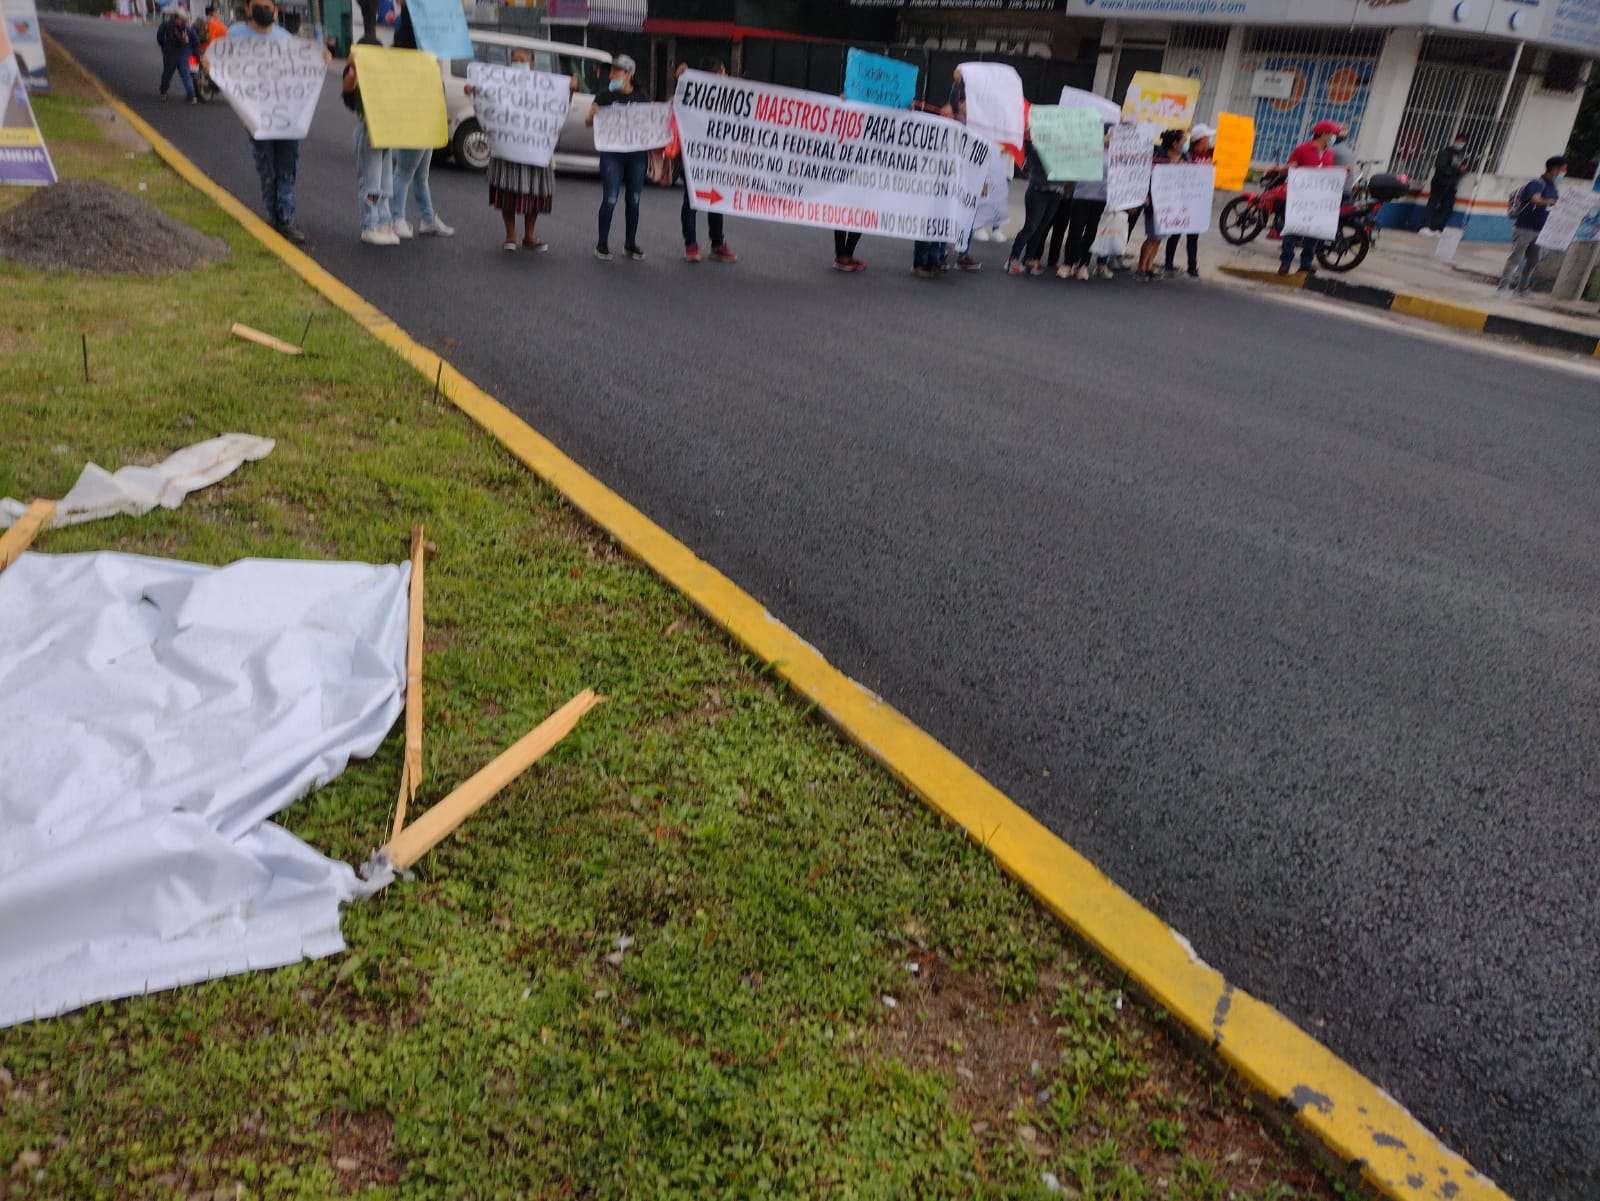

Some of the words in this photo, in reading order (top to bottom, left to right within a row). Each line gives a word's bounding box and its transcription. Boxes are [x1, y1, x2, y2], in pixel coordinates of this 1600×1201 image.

[682, 80, 754, 118] EXIGIMOS
[754, 92, 831, 134] MAESTROS
[830, 108, 865, 144] FIJOS
[863, 115, 896, 146] PARA
[897, 120, 949, 152] ESCUELA
[969, 138, 989, 167] 100
[767, 155, 784, 174] NO
[787, 159, 821, 180] ESTAN
[821, 166, 877, 189] RECIBIENDO
[878, 172, 890, 191] LA
[782, 134, 836, 161] FEDERAL
[838, 144, 853, 162] DE
[854, 145, 918, 173] ALEMANIA
[920, 155, 958, 177] ZONA
[705, 170, 750, 188] PETICIONES
[751, 179, 797, 197] REALIZADAS
[797, 185, 804, 197] Y
[733, 190, 744, 211] EL
[747, 192, 805, 220] MINISTERIO
[807, 203, 821, 222] DE
[822, 205, 879, 230] EDUCACION
[880, 211, 896, 232] NO
[898, 213, 919, 235] NOS
